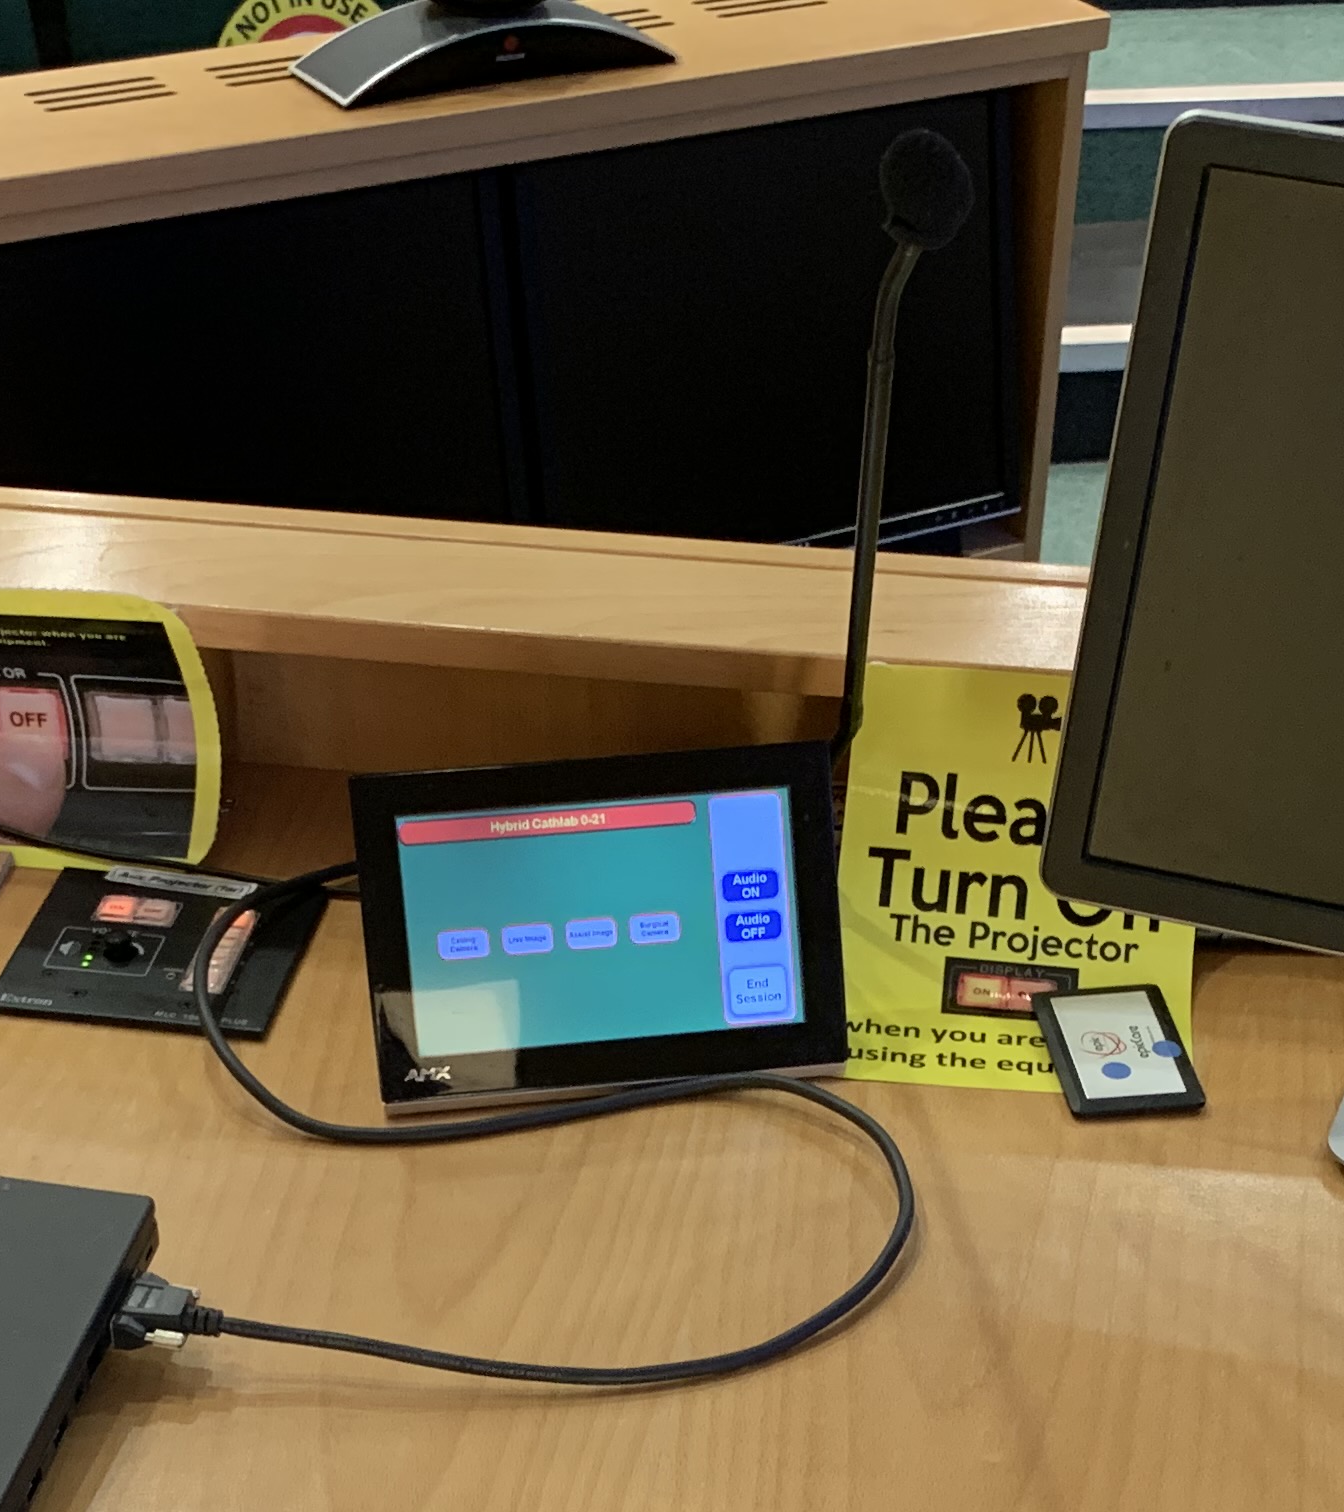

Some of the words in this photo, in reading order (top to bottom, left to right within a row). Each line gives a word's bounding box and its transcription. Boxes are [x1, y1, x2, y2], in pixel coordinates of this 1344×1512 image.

[41, 630, 77, 639] when
[9, 711, 48, 728] OFF
[895, 770, 1047, 846] Plea
[490, 818, 529, 834] Hybrid
[532, 815, 579, 830] Cathlab
[581, 813, 606, 826] 0-21
[149, 874, 212, 891] Projector
[732, 872, 768, 886] Audio
[868, 846, 1028, 920] Turn
[742, 886, 760, 898] ON
[736, 914, 770, 927] Audio
[741, 926, 766, 940] OFF
[889, 913, 955, 946] The
[969, 921, 1139, 963] Projector
[979, 963, 1047, 977] DISPLAY
[746, 978, 769, 989] End
[973, 986, 991, 996] ON
[736, 992, 782, 1004] Session
[931, 1028, 986, 1047] you
[997, 1032, 1048, 1047] are
[846, 1046, 926, 1068] using
[937, 1048, 986, 1069] the
[997, 1058, 1056, 1075] equ
[404, 1065, 451, 1082] AMX
